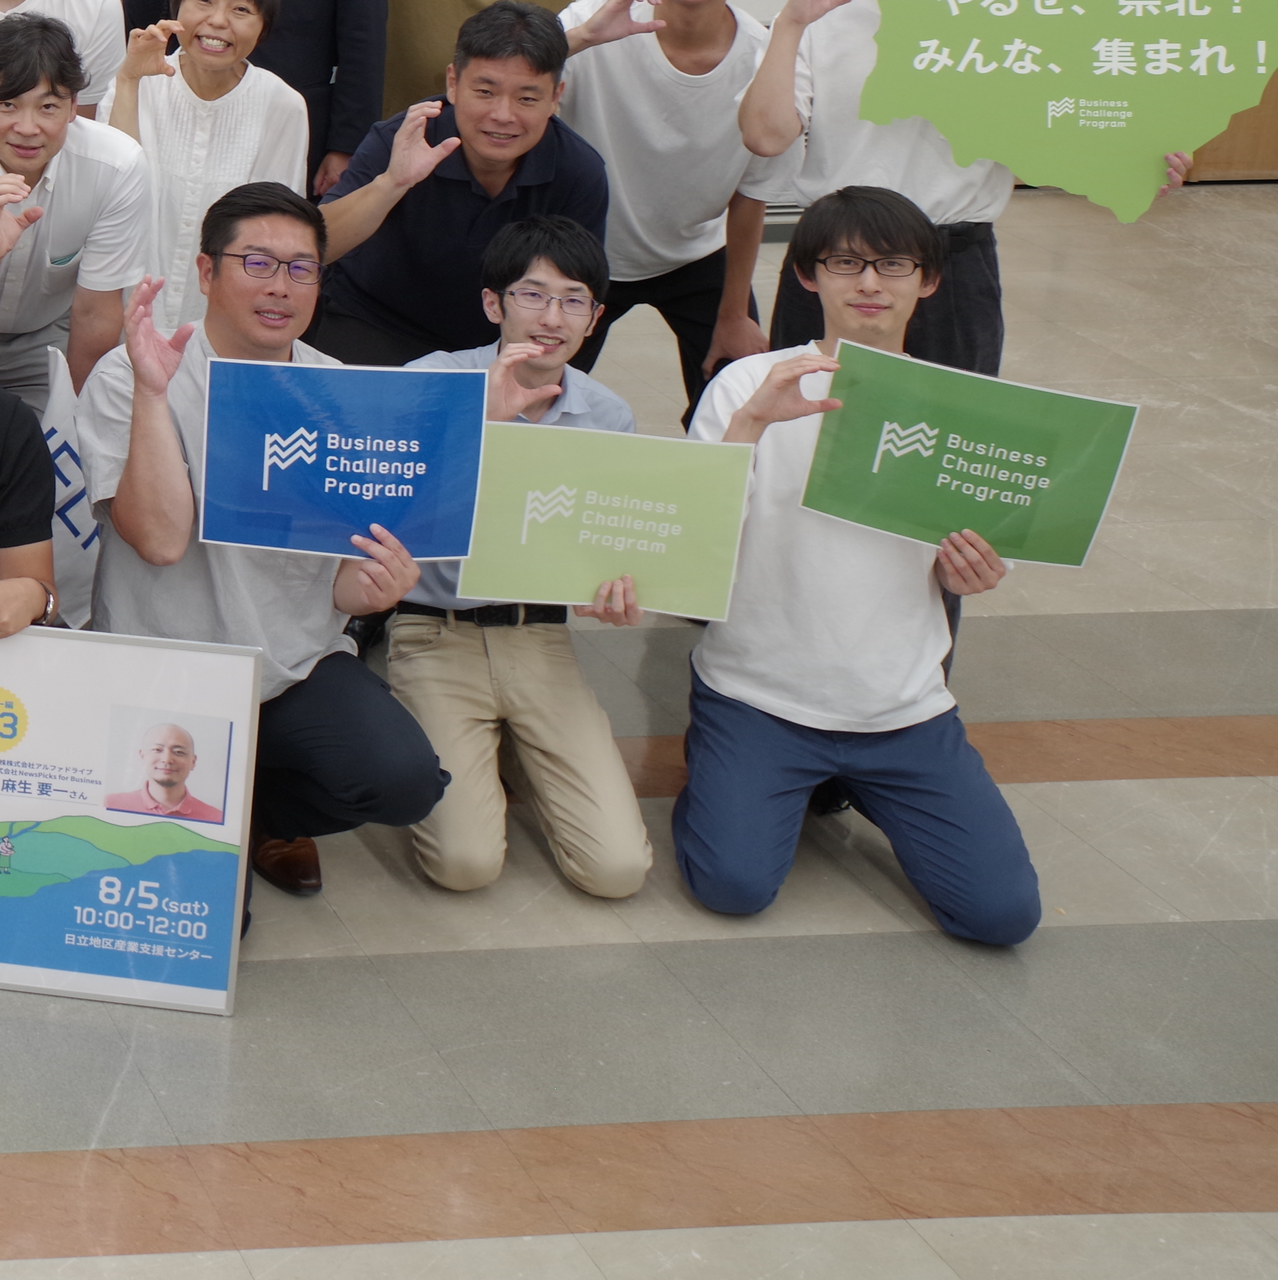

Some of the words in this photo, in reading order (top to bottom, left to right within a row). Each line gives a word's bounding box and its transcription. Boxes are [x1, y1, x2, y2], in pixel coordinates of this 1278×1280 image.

[1079, 99, 1129, 108] Business
[1079, 109, 1133, 119] Challenge
[1079, 119, 1127, 129] Program
[325, 433, 420, 453] Business
[946, 433, 1048, 467] Business
[324, 455, 427, 476] Challenge
[941, 453, 1051, 490] Challenge
[323, 478, 414, 500] Program
[935, 473, 1032, 507] Program
[584, 490, 678, 515] Business
[580, 510, 682, 537] Challenge
[577, 530, 667, 555] Program
[1, 778, 33, 794] 麻生
[70, 776, 102, 785] Business
[73, 905, 207, 939] 10:00-12:00
[64, 933, 213, 961] 日立地区産業支援センター
